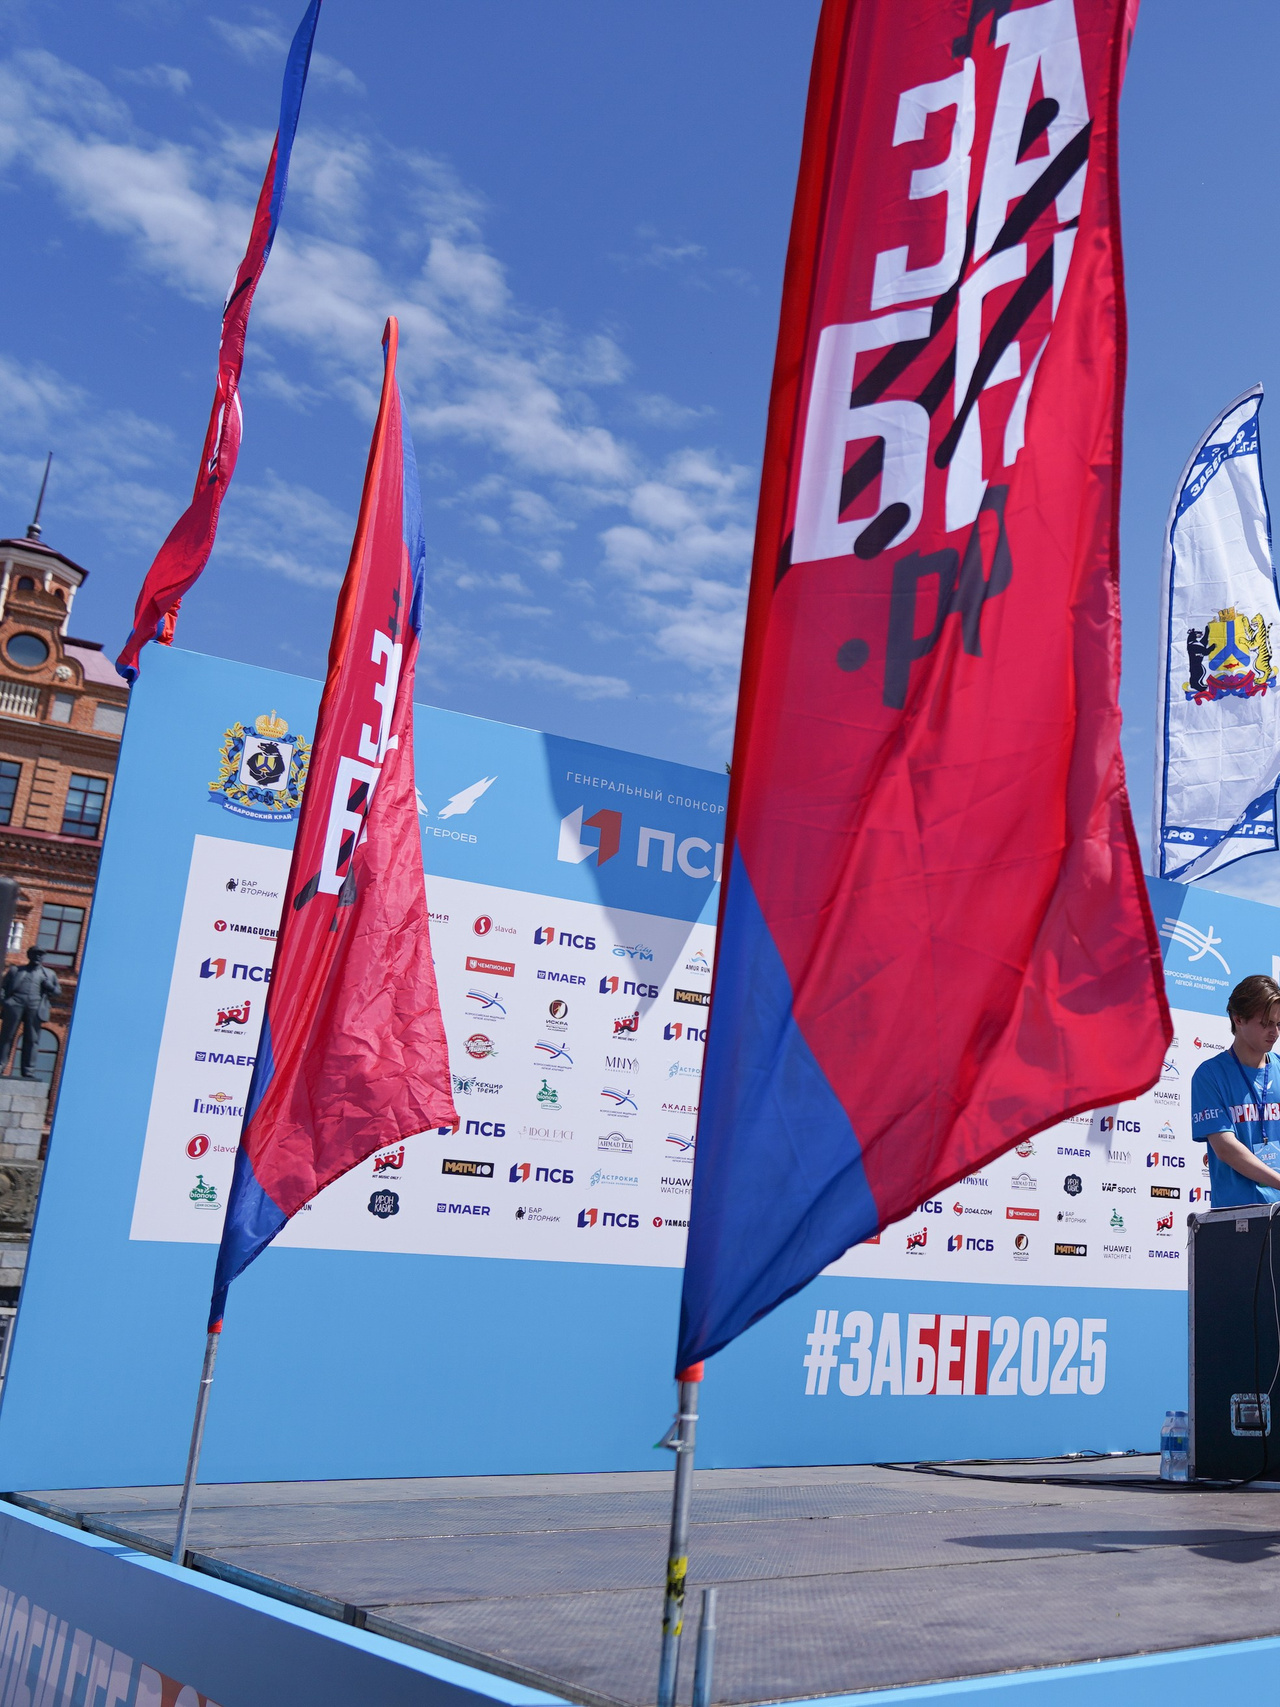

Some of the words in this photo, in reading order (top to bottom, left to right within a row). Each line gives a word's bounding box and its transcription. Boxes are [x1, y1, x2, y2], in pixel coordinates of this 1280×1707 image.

[1190, 430, 1245, 497] ЗАБЕГ.РФ
[566, 771, 664, 802] ГЕНЕРАЛЬНЫЙ
[667, 793, 725, 815] СПОНСОР
[224, 803, 273, 820] ХАБАРОВСКИЙ
[425, 826, 478, 844] ГЕРОЕВ
[241, 879, 258, 887] БАР
[240, 887, 279, 898] ВТОРНИК
[558, 932, 596, 951] ПСБ
[612, 948, 654, 962] GYM
[547, 971, 587, 986] MAER
[623, 981, 659, 998] ПСБ
[686, 1027, 708, 1043] ПС
[208, 1052, 257, 1067] MAER
[605, 1056, 634, 1070] MNY
[475, 1081, 504, 1090] ХЕХЦИР
[1154, 1091, 1181, 1101] HUAWEI
[661, 1102, 700, 1112] АКАДЕМ
[465, 1120, 506, 1138] ПСБ
[1116, 1119, 1141, 1133] ПСБ
[1064, 1147, 1091, 1157] MAER
[1162, 1155, 1186, 1168] ПСБ
[535, 1167, 574, 1184] ПСБ
[601, 1174, 639, 1183] АСТРОКИД
[661, 1176, 693, 1186] HUAW
[660, 1186, 684, 1194] WATCH
[1117, 1186, 1136, 1194] sport
[448, 1203, 491, 1216] MAER
[527, 1214, 561, 1223] ВТОРНИК
[602, 1212, 640, 1228] ПСБ
[966, 1238, 994, 1252] ПСБ
[1103, 1244, 1132, 1253] HUAWEI
[1155, 1250, 1180, 1259] MAER
[803, 1309, 1108, 1397] #ЗАБЕГ2025
